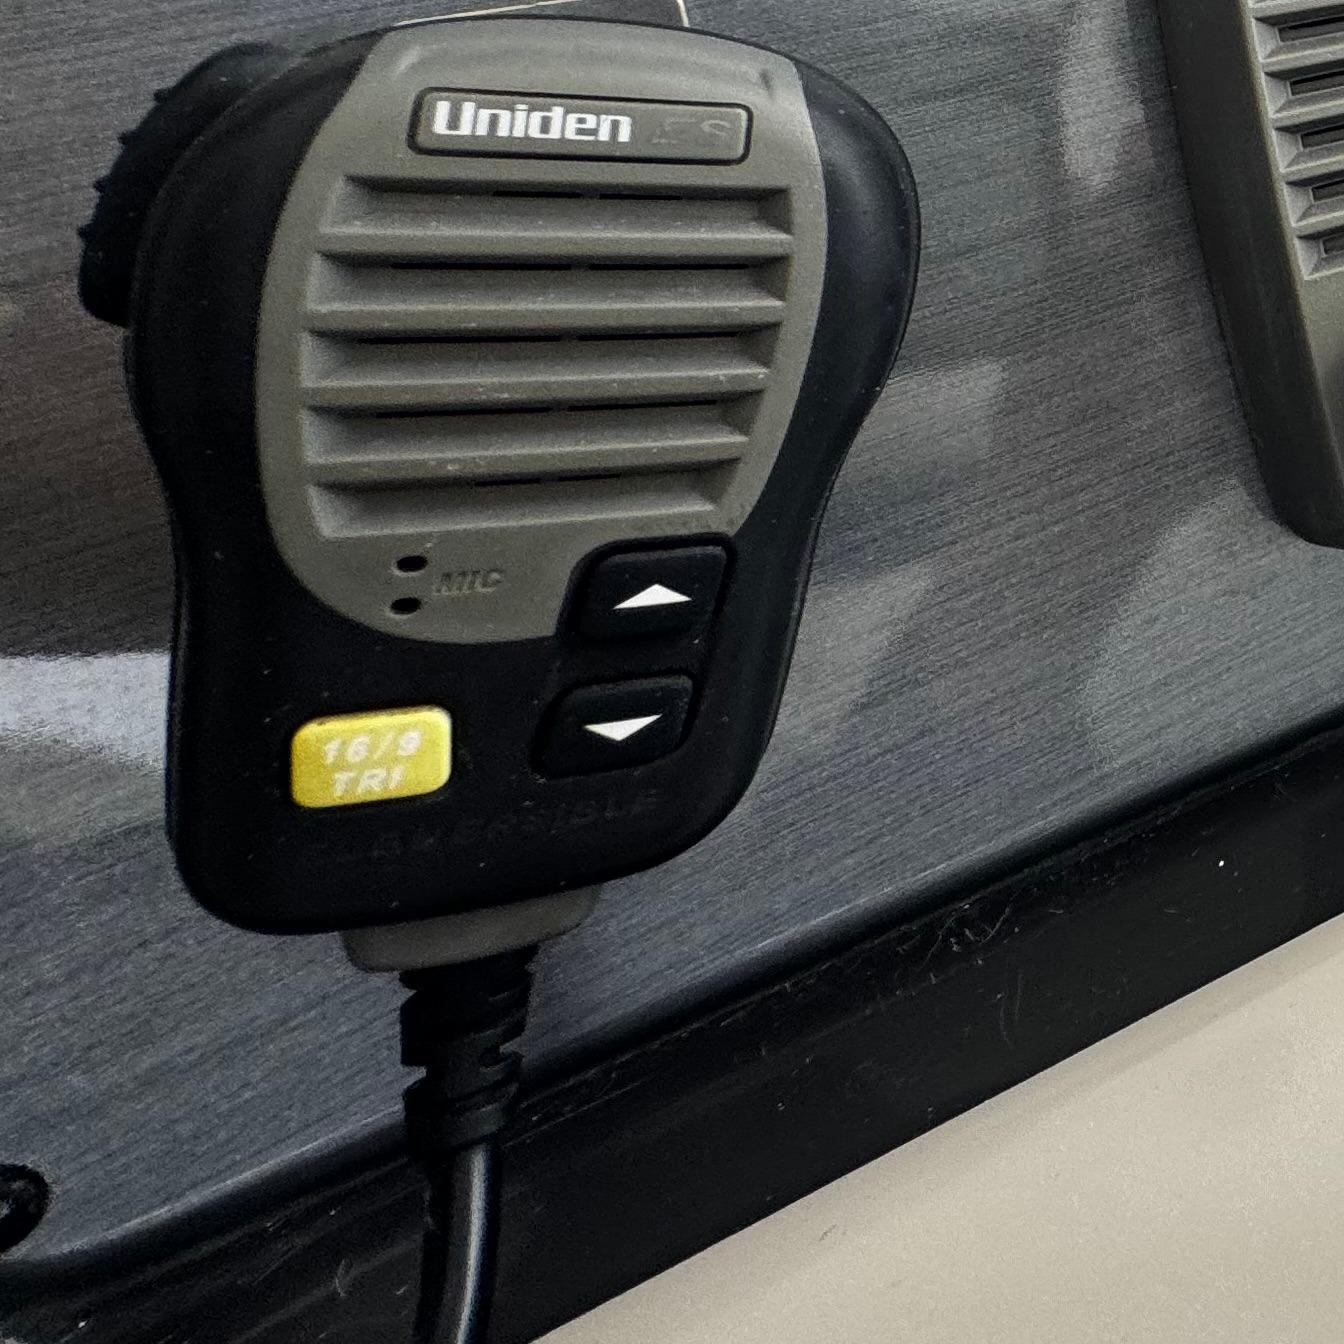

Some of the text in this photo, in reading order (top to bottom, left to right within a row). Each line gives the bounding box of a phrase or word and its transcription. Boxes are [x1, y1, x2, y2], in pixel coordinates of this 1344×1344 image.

[432, 100, 632, 143] Uniden
[323, 729, 422, 766] 16/9
[333, 765, 405, 798] TRI
